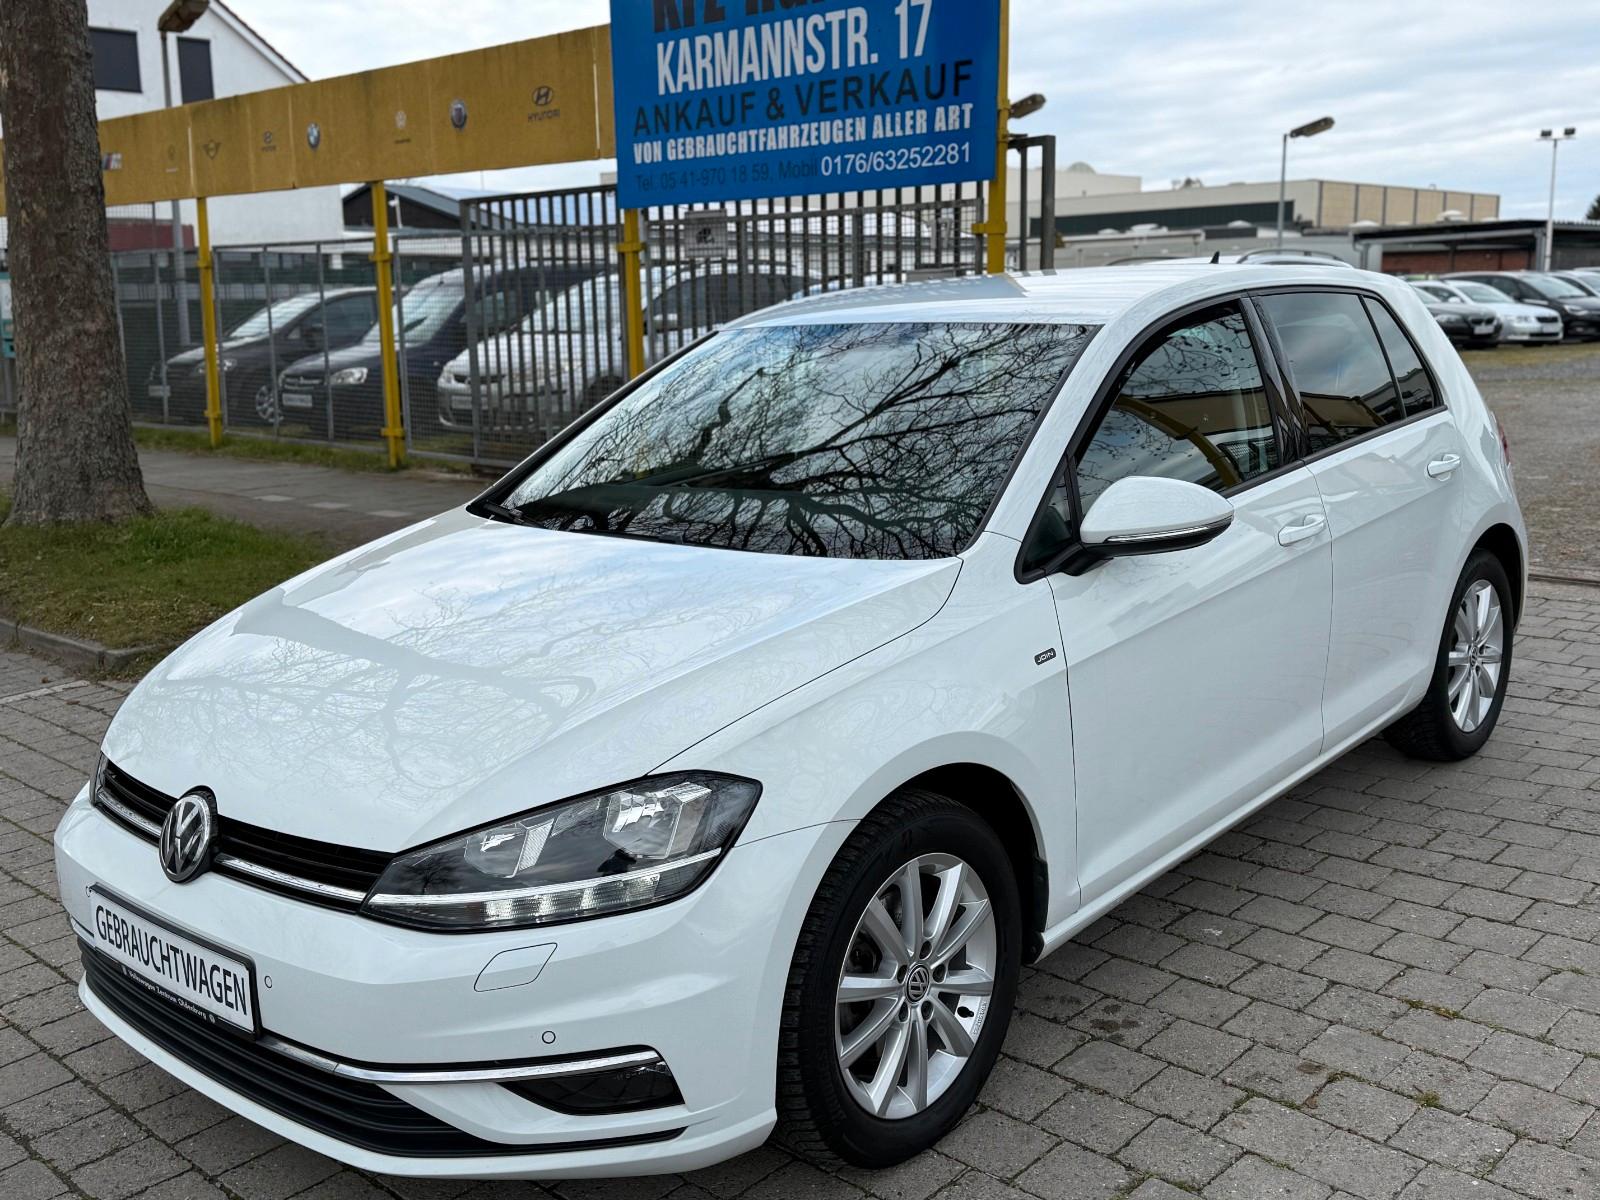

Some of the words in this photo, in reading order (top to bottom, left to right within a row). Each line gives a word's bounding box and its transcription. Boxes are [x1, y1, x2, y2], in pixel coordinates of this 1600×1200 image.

[657, 7, 879, 96] KARMANNSTR.
[894, 0, 933, 60] 17
[633, 140, 663, 165] VON
[667, 116, 867, 162] GEBRAUCHTFAHRZEUGEN
[872, 108, 928, 140] ALLER
[934, 103, 974, 133] ART
[634, 89, 756, 137] ANKAUF
[766, 87, 785, 121] &
[795, 59, 974, 117] VERKAUF
[661, 172, 676, 190] 05
[733, 165, 748, 183] 18
[778, 157, 818, 179] Mobil
[820, 141, 971, 177] 0176/63252281
[95, 904, 249, 1017] GEBRAUCHTWAGEN
